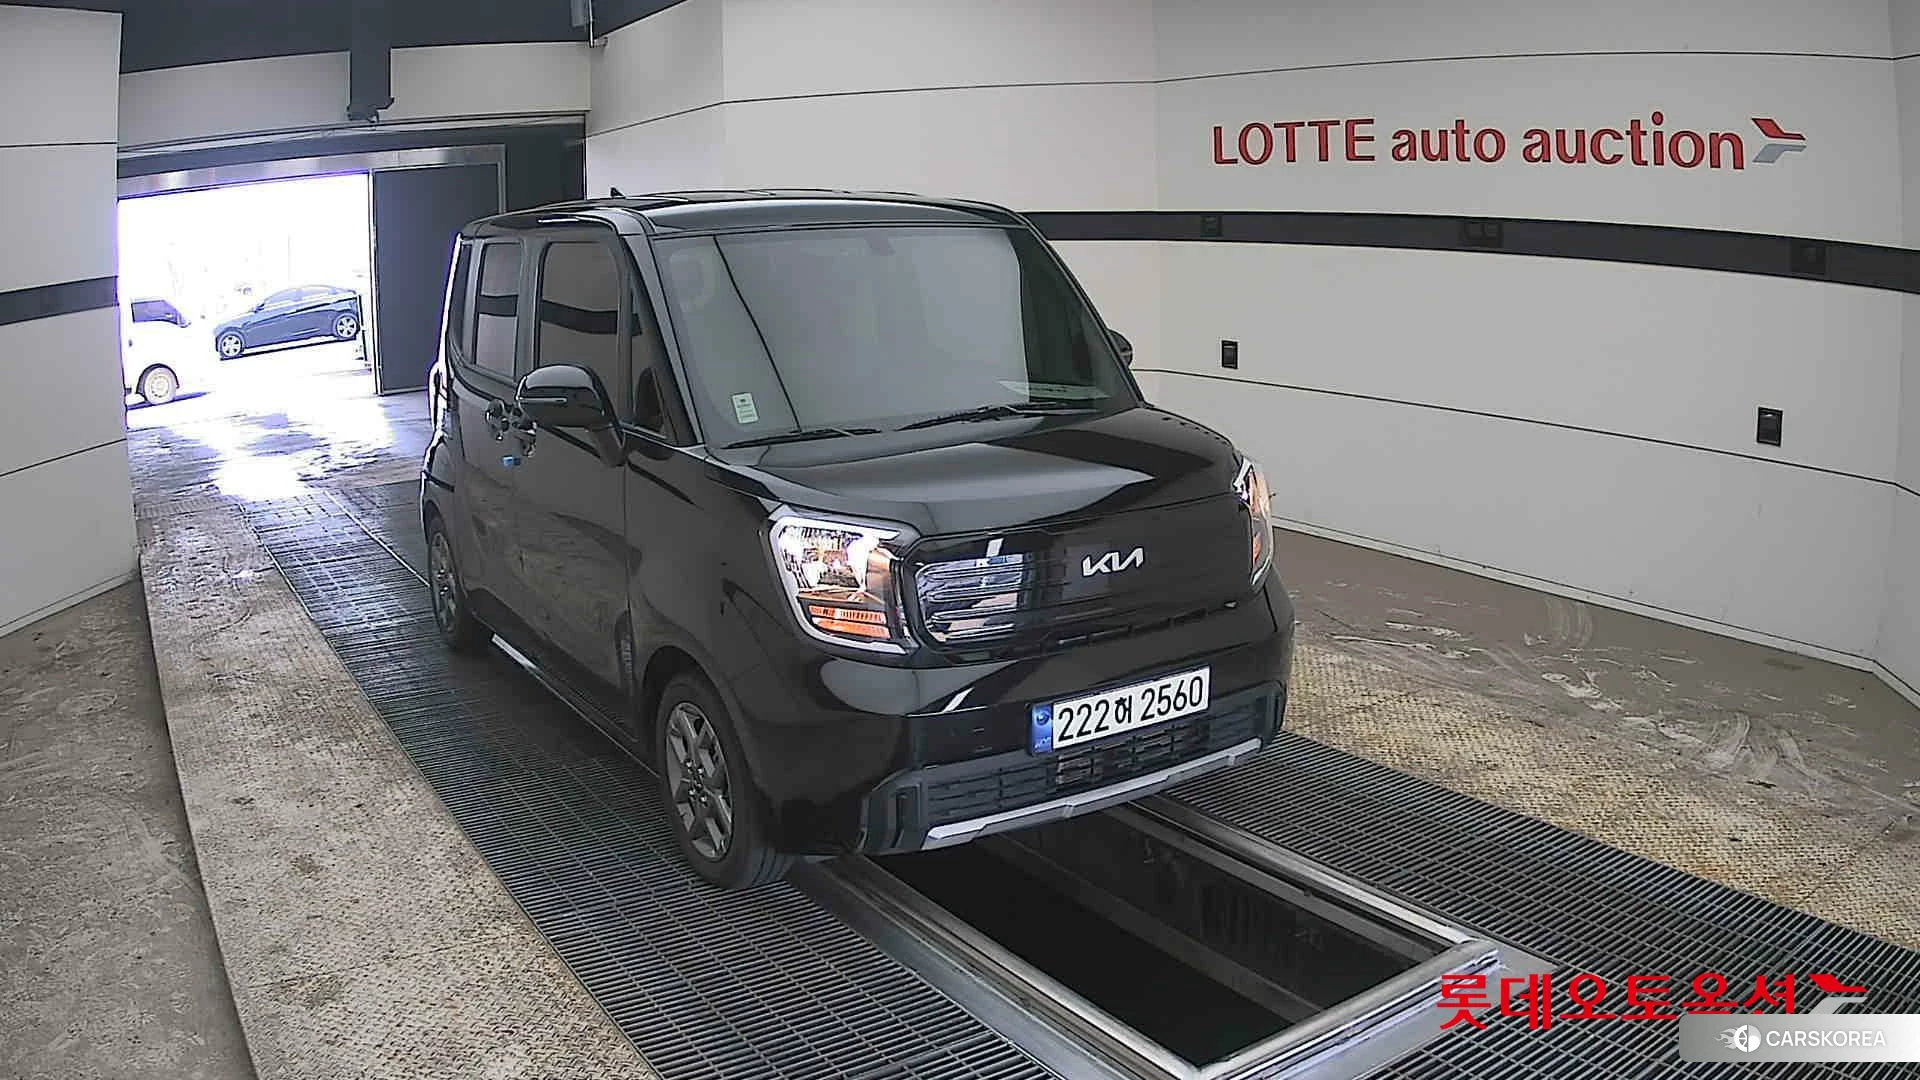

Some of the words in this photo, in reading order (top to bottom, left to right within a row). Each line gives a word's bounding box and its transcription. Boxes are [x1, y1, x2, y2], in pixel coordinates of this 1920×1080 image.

[1212, 118, 1376, 165] LOTTE
[1391, 118, 1507, 162] auto
[1522, 111, 1745, 170] auction
[1082, 547, 1144, 576] KIA
[1058, 695, 1133, 742] 222허
[1140, 676, 1204, 721] 2560
